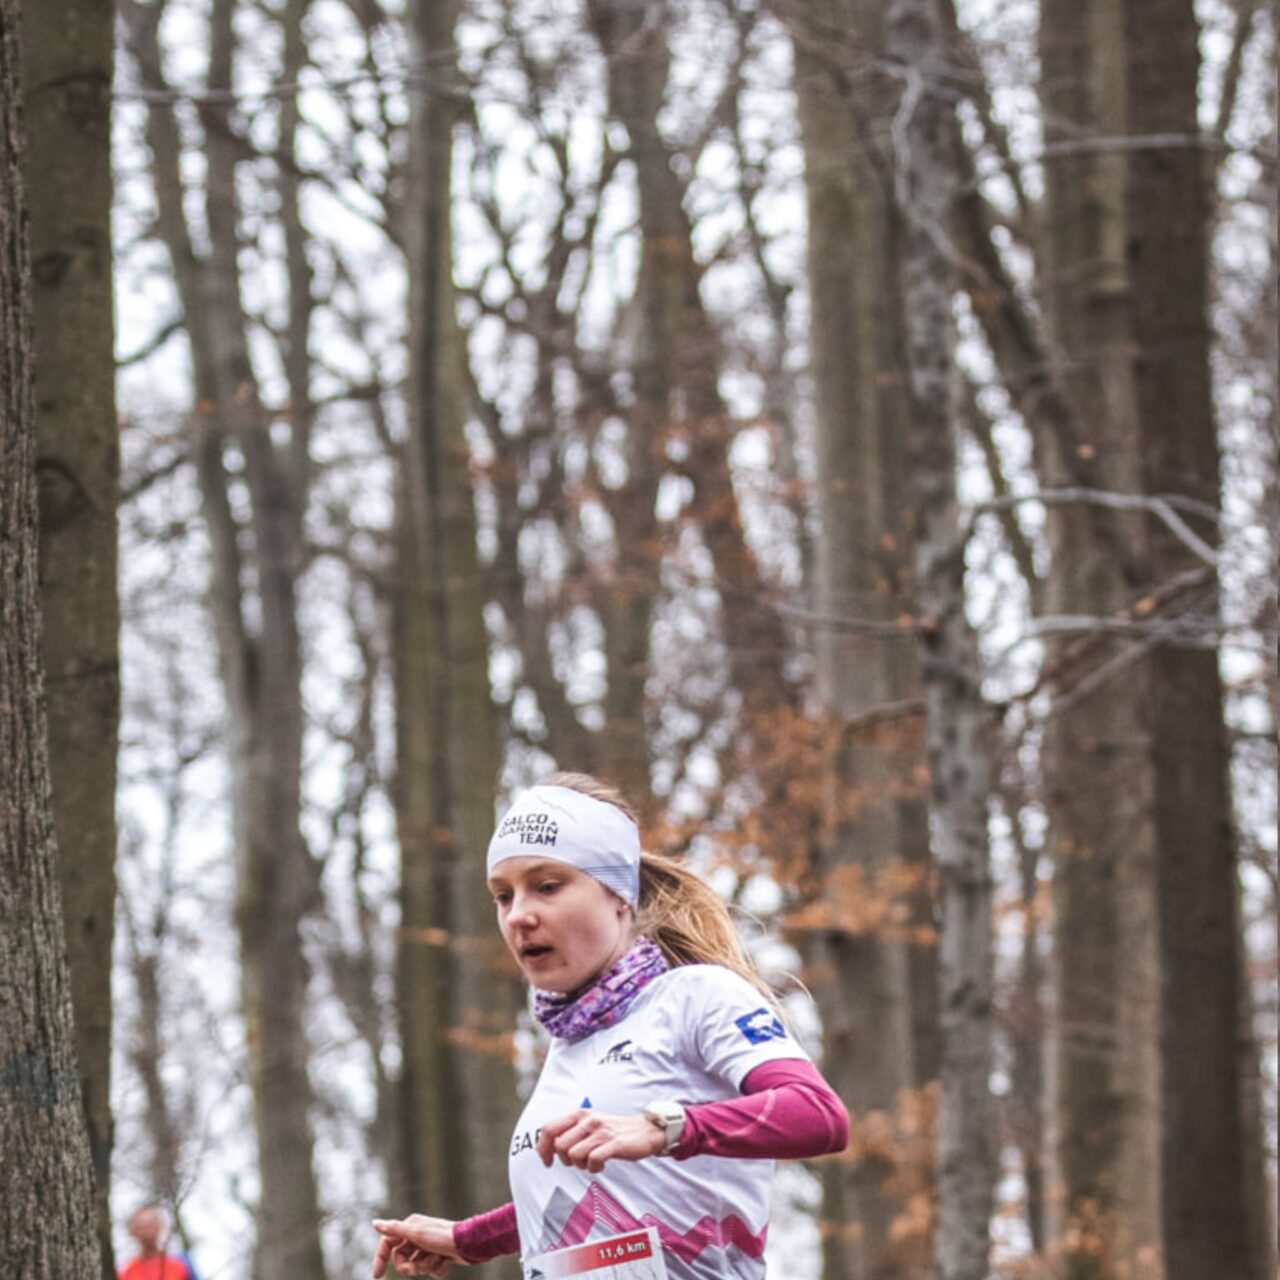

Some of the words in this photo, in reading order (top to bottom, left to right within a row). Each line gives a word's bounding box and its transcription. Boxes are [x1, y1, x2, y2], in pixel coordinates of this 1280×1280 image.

[520, 832, 557, 847] TEAM
[599, 1244, 625, 1260] 11,6
[626, 1241, 646, 1254] km
